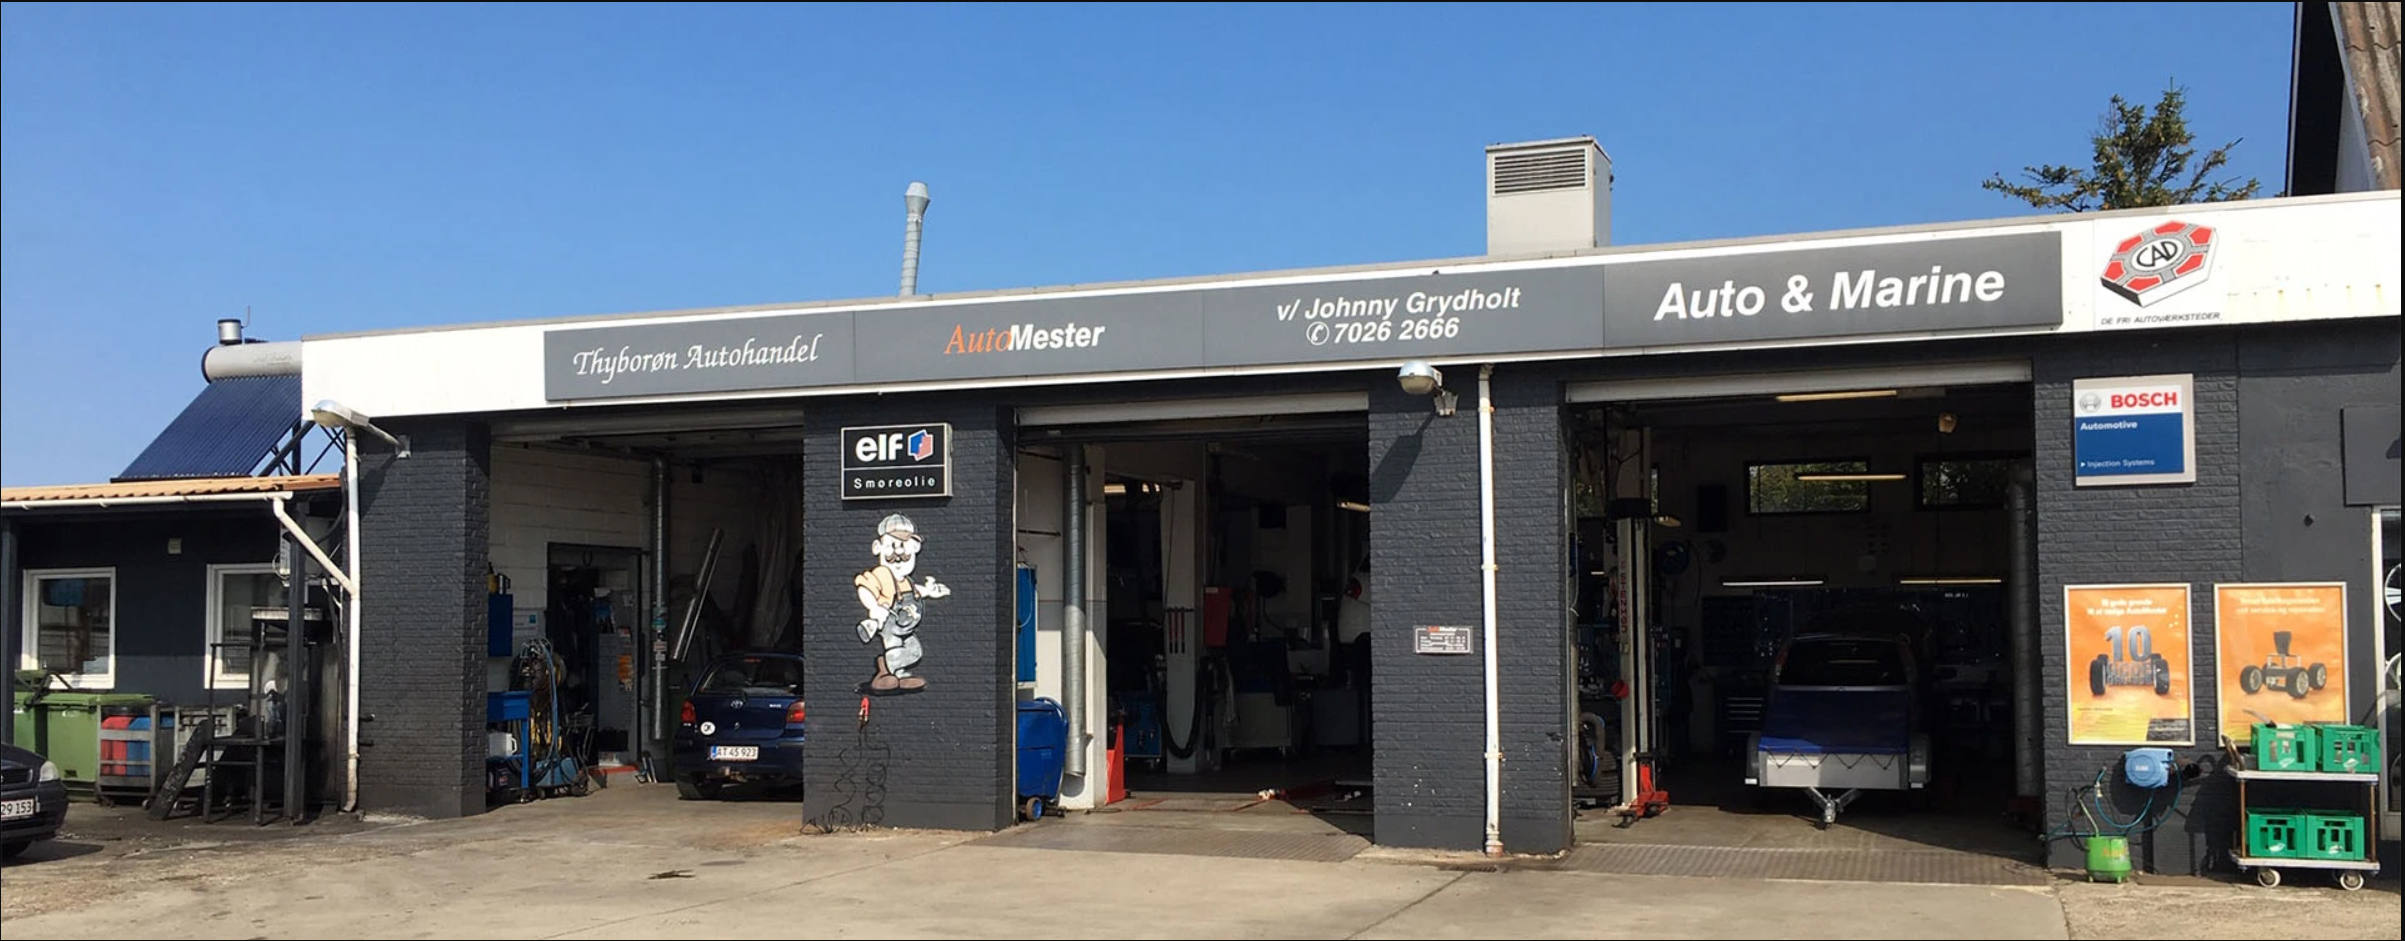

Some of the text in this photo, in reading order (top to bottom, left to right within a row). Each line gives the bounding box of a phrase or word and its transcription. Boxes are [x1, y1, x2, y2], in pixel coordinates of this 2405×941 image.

[2136, 241, 2178, 267] CAD
[1277, 287, 1521, 321] v/ Johnny Grydholt
[1654, 265, 2005, 321] Auto & Marine
[1334, 317, 1460, 343] 7026 2666
[2101, 317, 2113, 325] DE
[2116, 316, 2131, 325] FRI
[943, 322, 1105, 354] AutoMester
[573, 333, 823, 384] Thyborøn Autohandel
[2111, 392, 2177, 409] BOSCH
[2080, 421, 2138, 431] Automotive
[855, 433, 903, 462] elf
[2087, 459, 2155, 468] Injection Systems
[2105, 625, 2152, 661] 10
[741, 748, 757, 757] 923
[16, 802, 32, 815] 153
